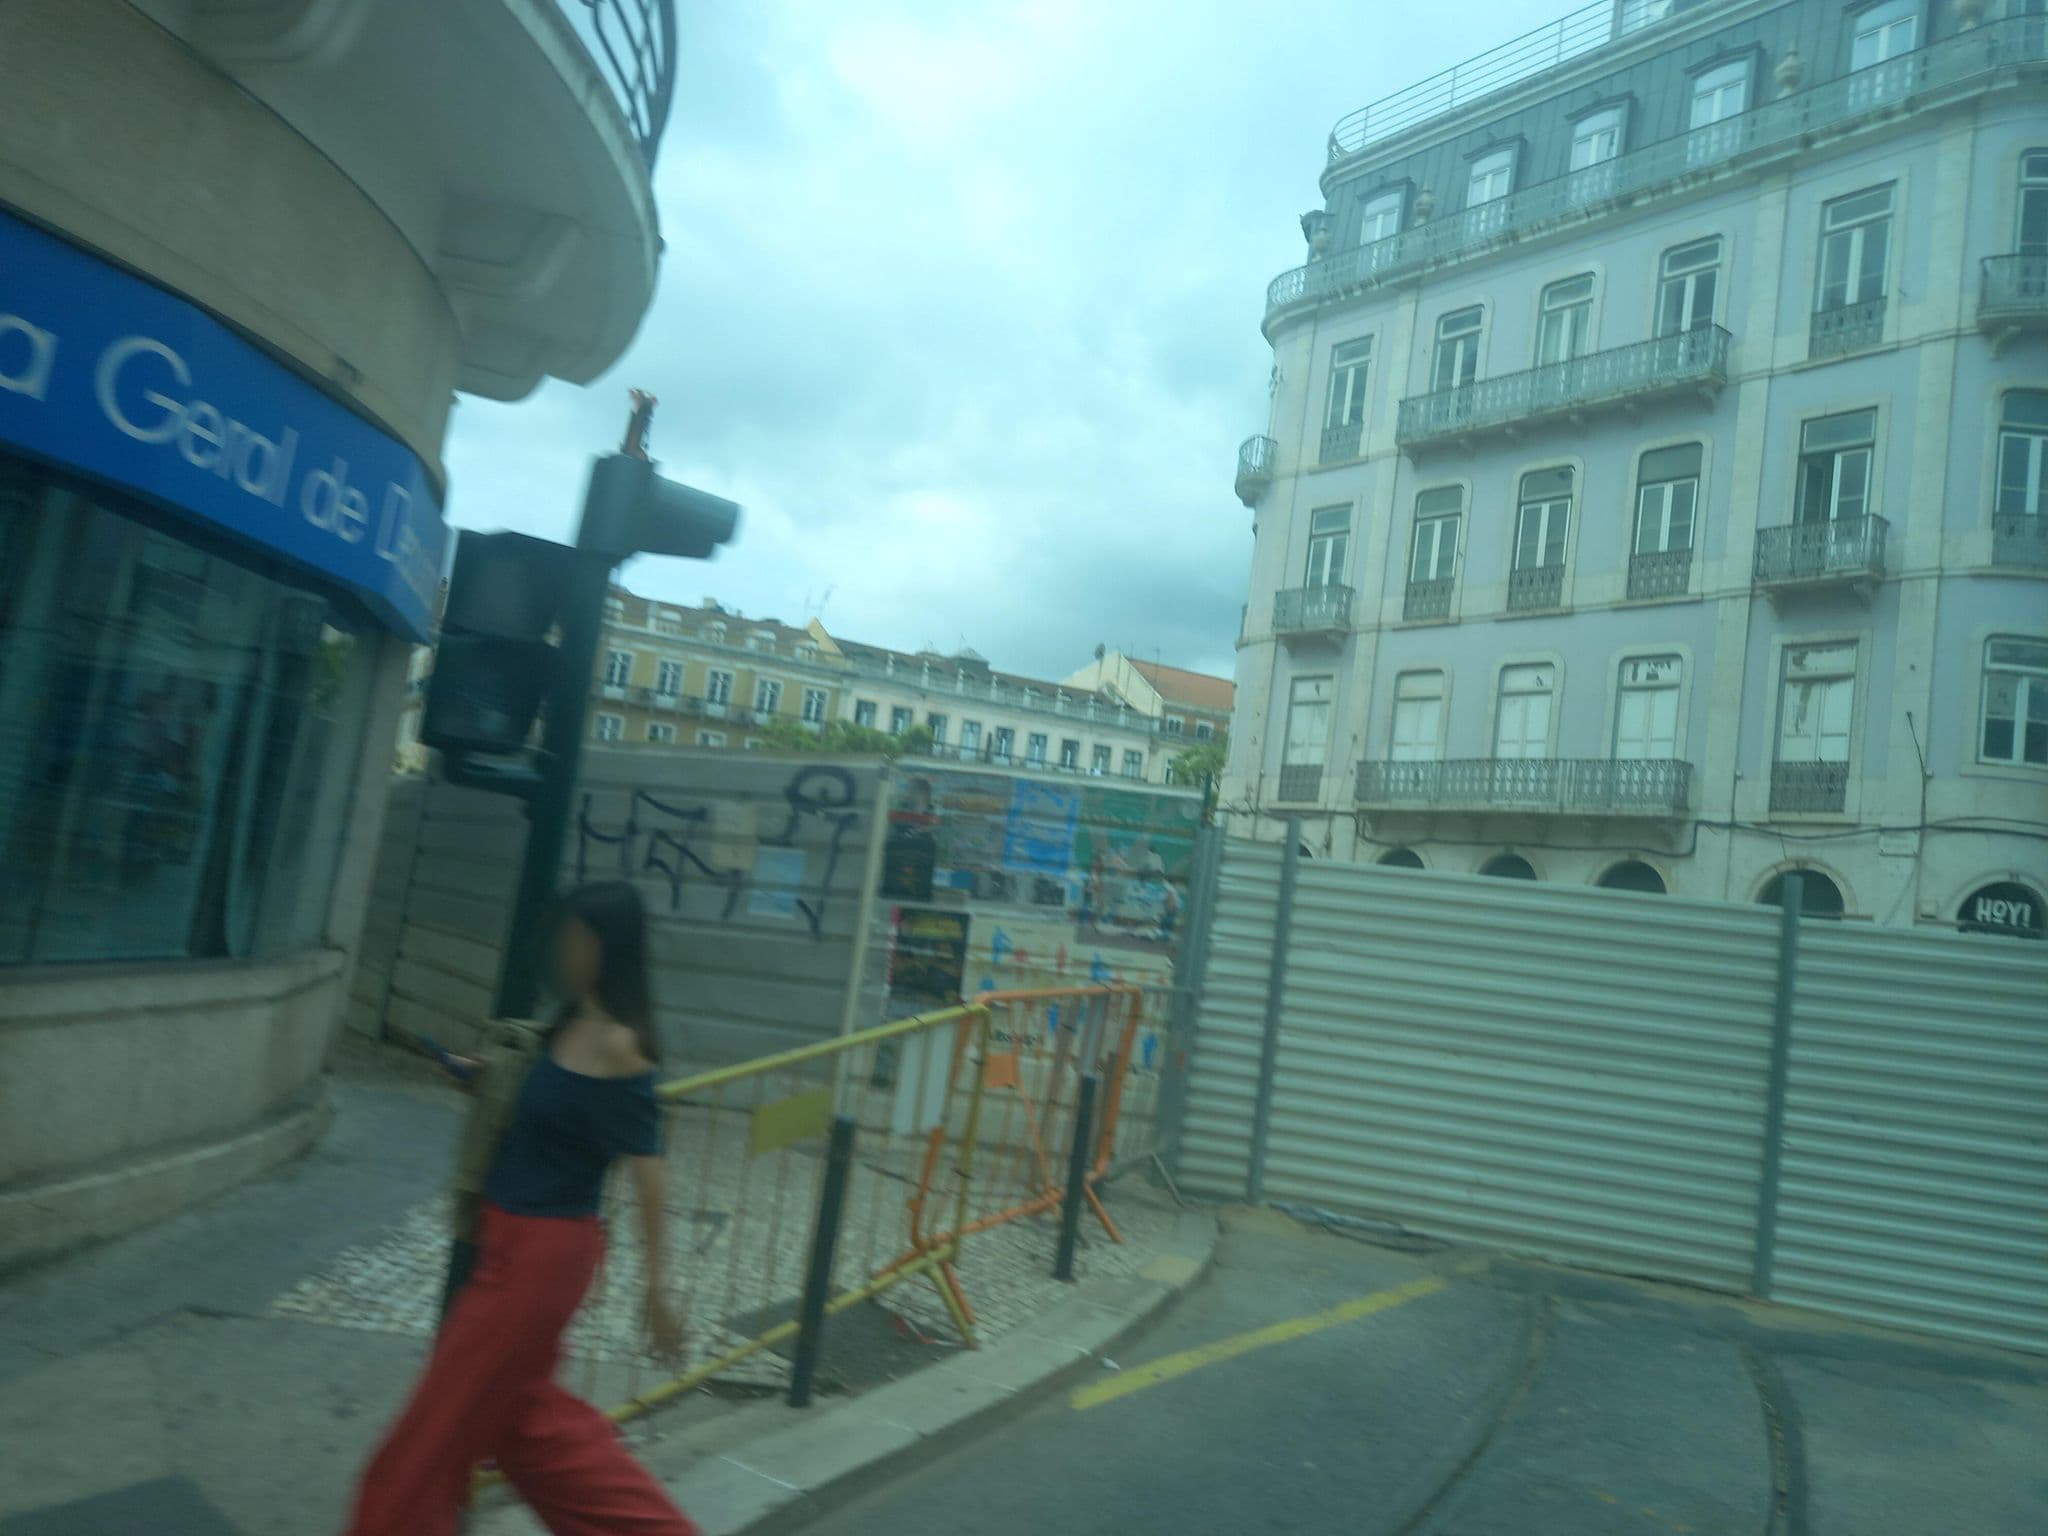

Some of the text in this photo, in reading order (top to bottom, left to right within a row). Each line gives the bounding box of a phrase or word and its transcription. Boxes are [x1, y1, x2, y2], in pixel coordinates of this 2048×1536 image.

[95, 334, 299, 508] Geral
[302, 456, 370, 543] de
[1976, 896, 2032, 929] HOY!
